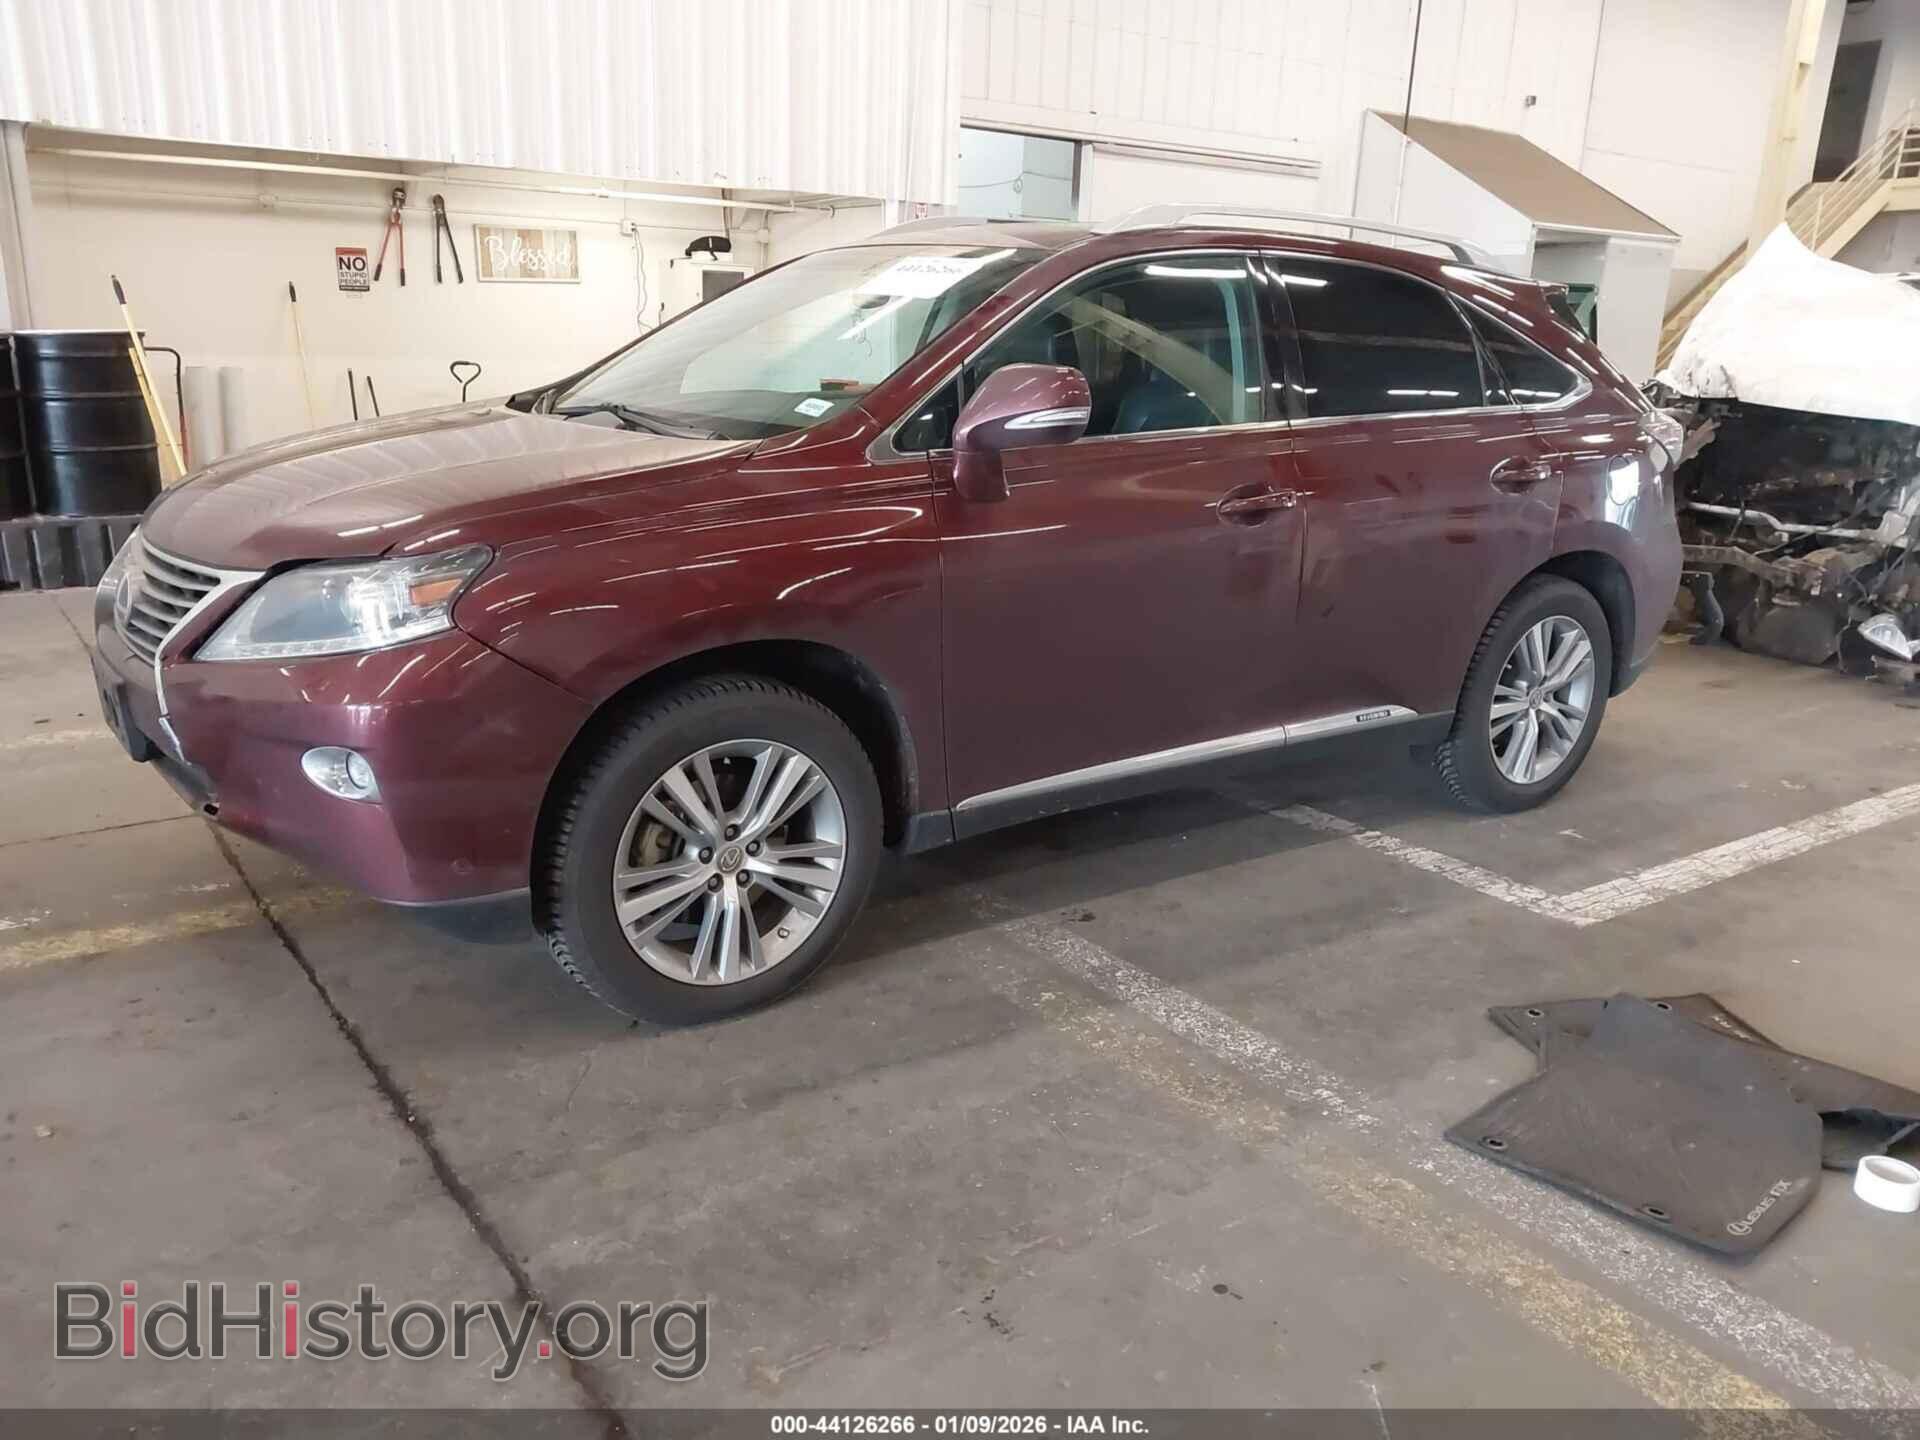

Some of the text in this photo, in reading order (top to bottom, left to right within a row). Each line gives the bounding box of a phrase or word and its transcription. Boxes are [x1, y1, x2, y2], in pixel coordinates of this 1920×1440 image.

[484, 233, 575, 272] Blessed
[338, 256, 366, 271] NO
[340, 271, 367, 279] STUPID
